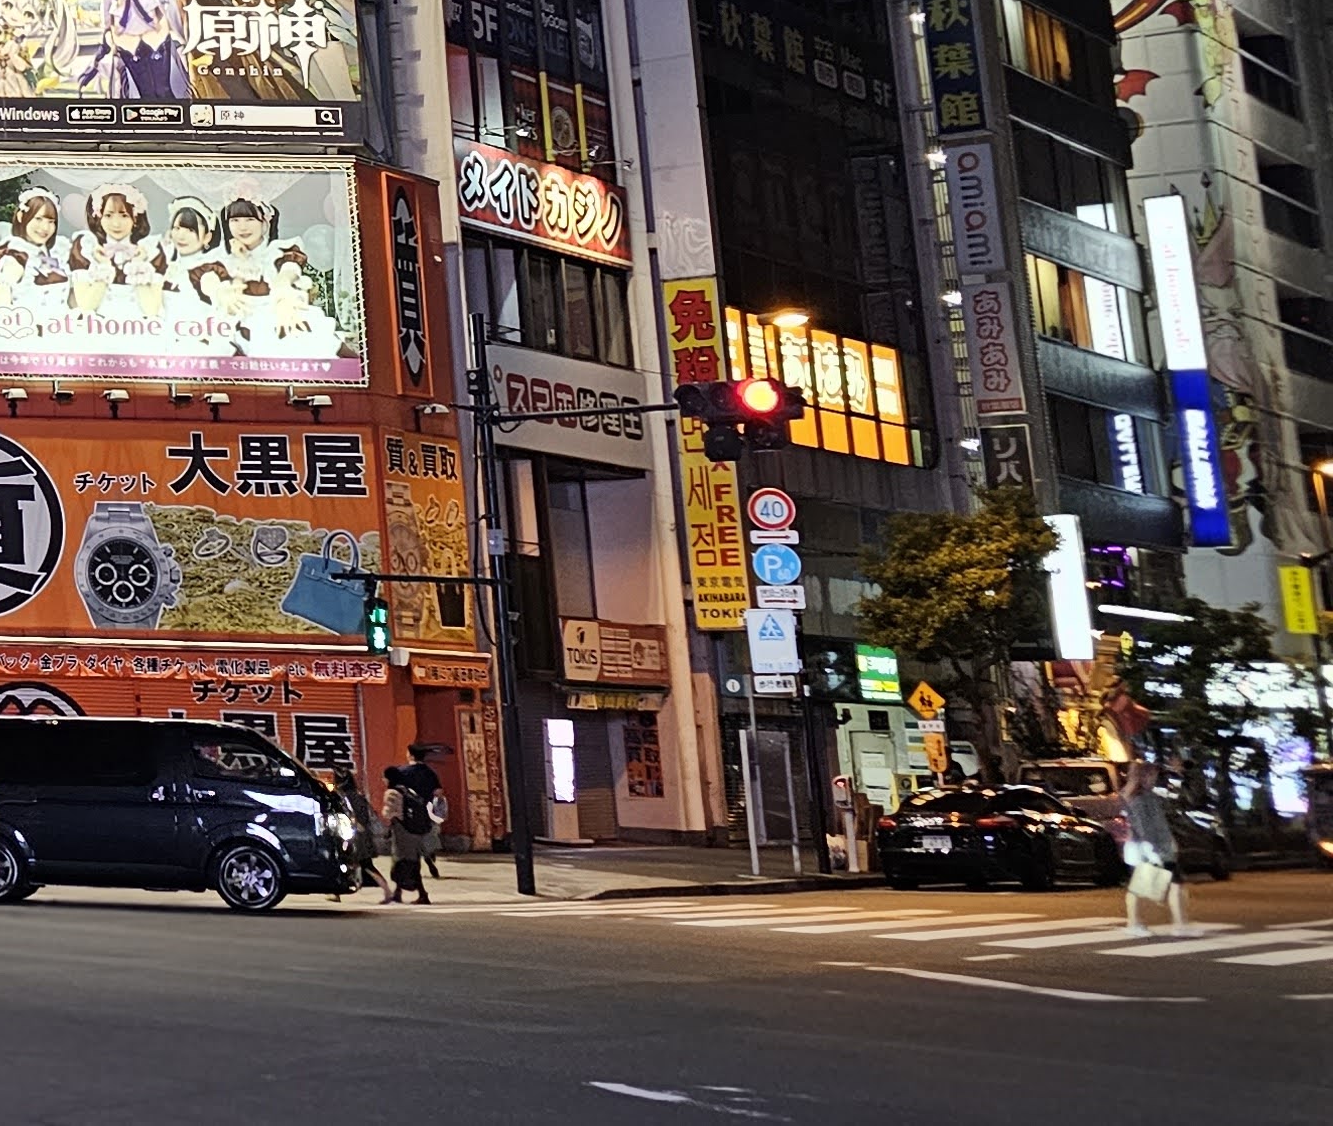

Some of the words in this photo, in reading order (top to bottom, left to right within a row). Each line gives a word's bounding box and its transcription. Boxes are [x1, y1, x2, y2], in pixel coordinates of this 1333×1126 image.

[470, 0, 499, 42] 5F
[197, 64, 285, 77] Genshin
[0, 107, 60, 122] Windows
[461, 152, 622, 250] メイドカジノ
[956, 150, 993, 270] amiami
[47, 313, 162, 336] at-home
[174, 317, 232, 337] cafe
[669, 289, 721, 383] 免税
[973, 289, 1012, 394] あみあみ
[506, 376, 644, 440] スマホ修理王
[165, 430, 370, 498] 大黒屋
[385, 436, 459, 481] 質&買取
[74, 472, 156, 495] チケット
[759, 500, 785, 519] 40
[714, 483, 742, 567] FREE
[764, 555, 783, 581] P
[698, 593, 747, 603] AKIHABARA
[700, 608, 747, 619] TOKIS
[312, 659, 385, 679] 無料査定
[567, 647, 598, 665] TOKIS
[192, 679, 304, 706] チケット
